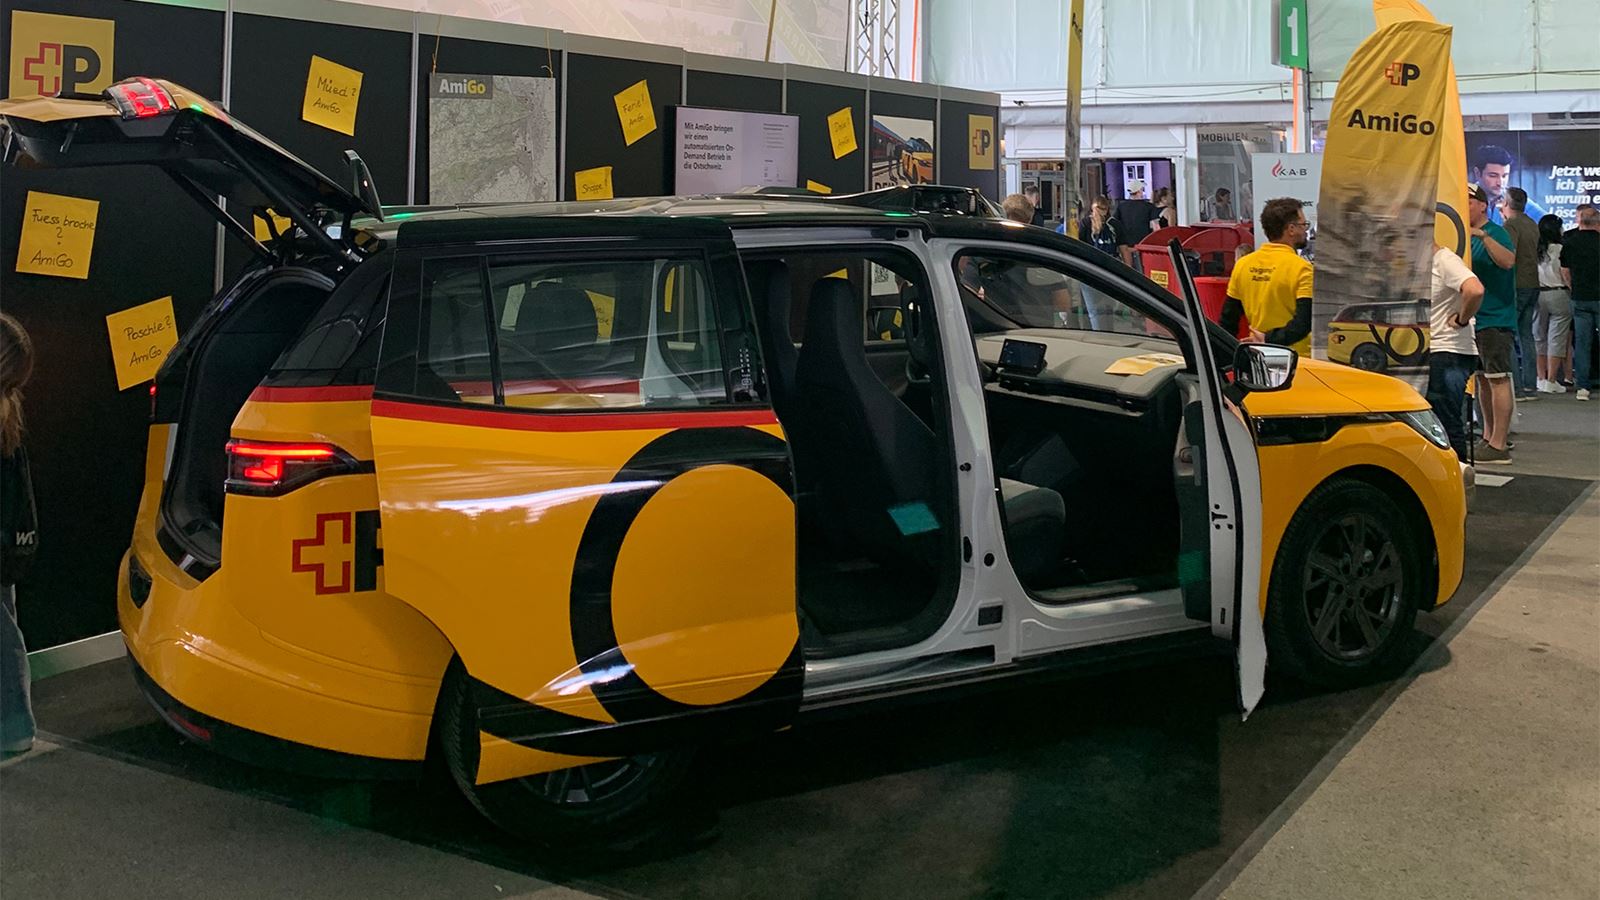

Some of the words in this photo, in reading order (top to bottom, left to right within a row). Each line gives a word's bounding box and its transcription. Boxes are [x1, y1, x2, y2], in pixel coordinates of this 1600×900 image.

[1287, 7, 1299, 57] 1
[439, 78, 486, 94] AmiGo
[684, 122, 694, 130] Mit
[695, 123, 713, 131] AmiGo
[1347, 109, 1435, 136] AmiGo
[684, 152, 706, 160] Demand
[1549, 165, 1582, 180] Jetzt
[1556, 178, 1575, 191] ich
[1545, 194, 1591, 204] warum
[30, 249, 74, 268] AmiGo
[129, 344, 163, 368] AmiGo
